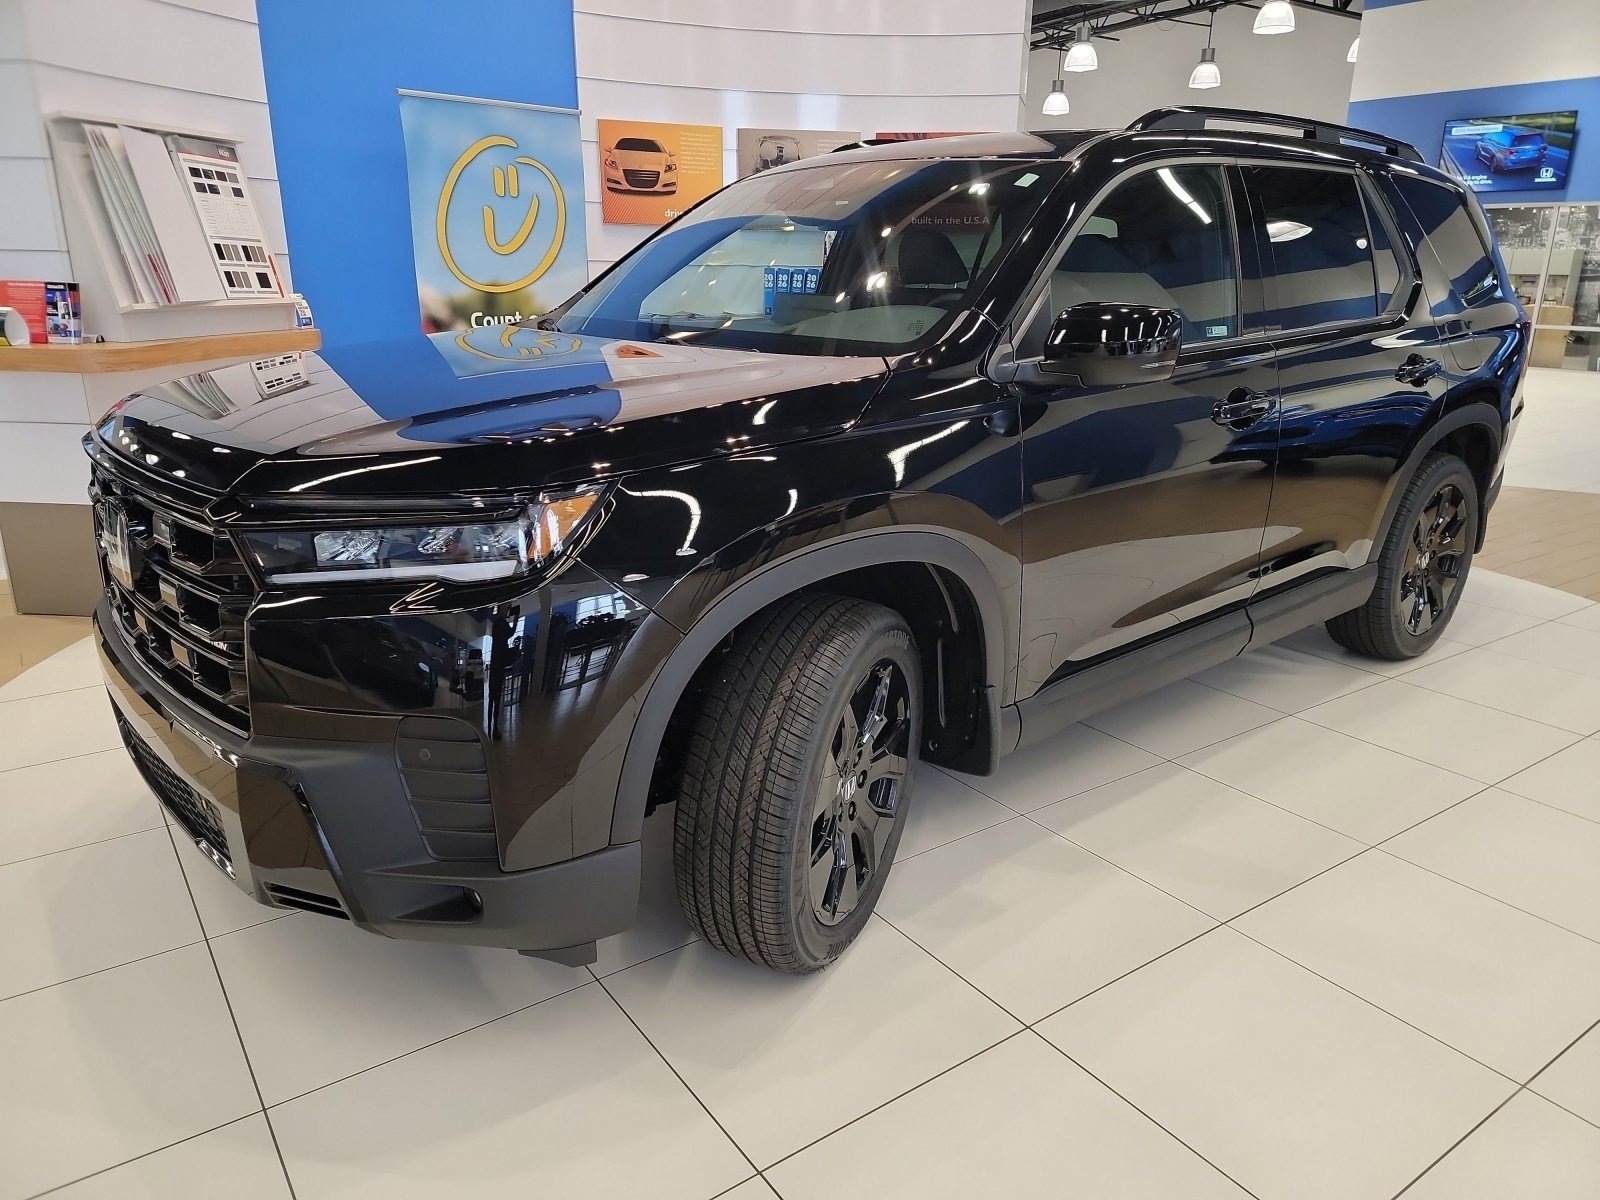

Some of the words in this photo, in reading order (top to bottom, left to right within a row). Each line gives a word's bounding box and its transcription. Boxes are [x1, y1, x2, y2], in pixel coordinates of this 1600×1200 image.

[911, 216, 932, 225] built
[934, 216, 943, 225] in
[945, 216, 961, 225] the
